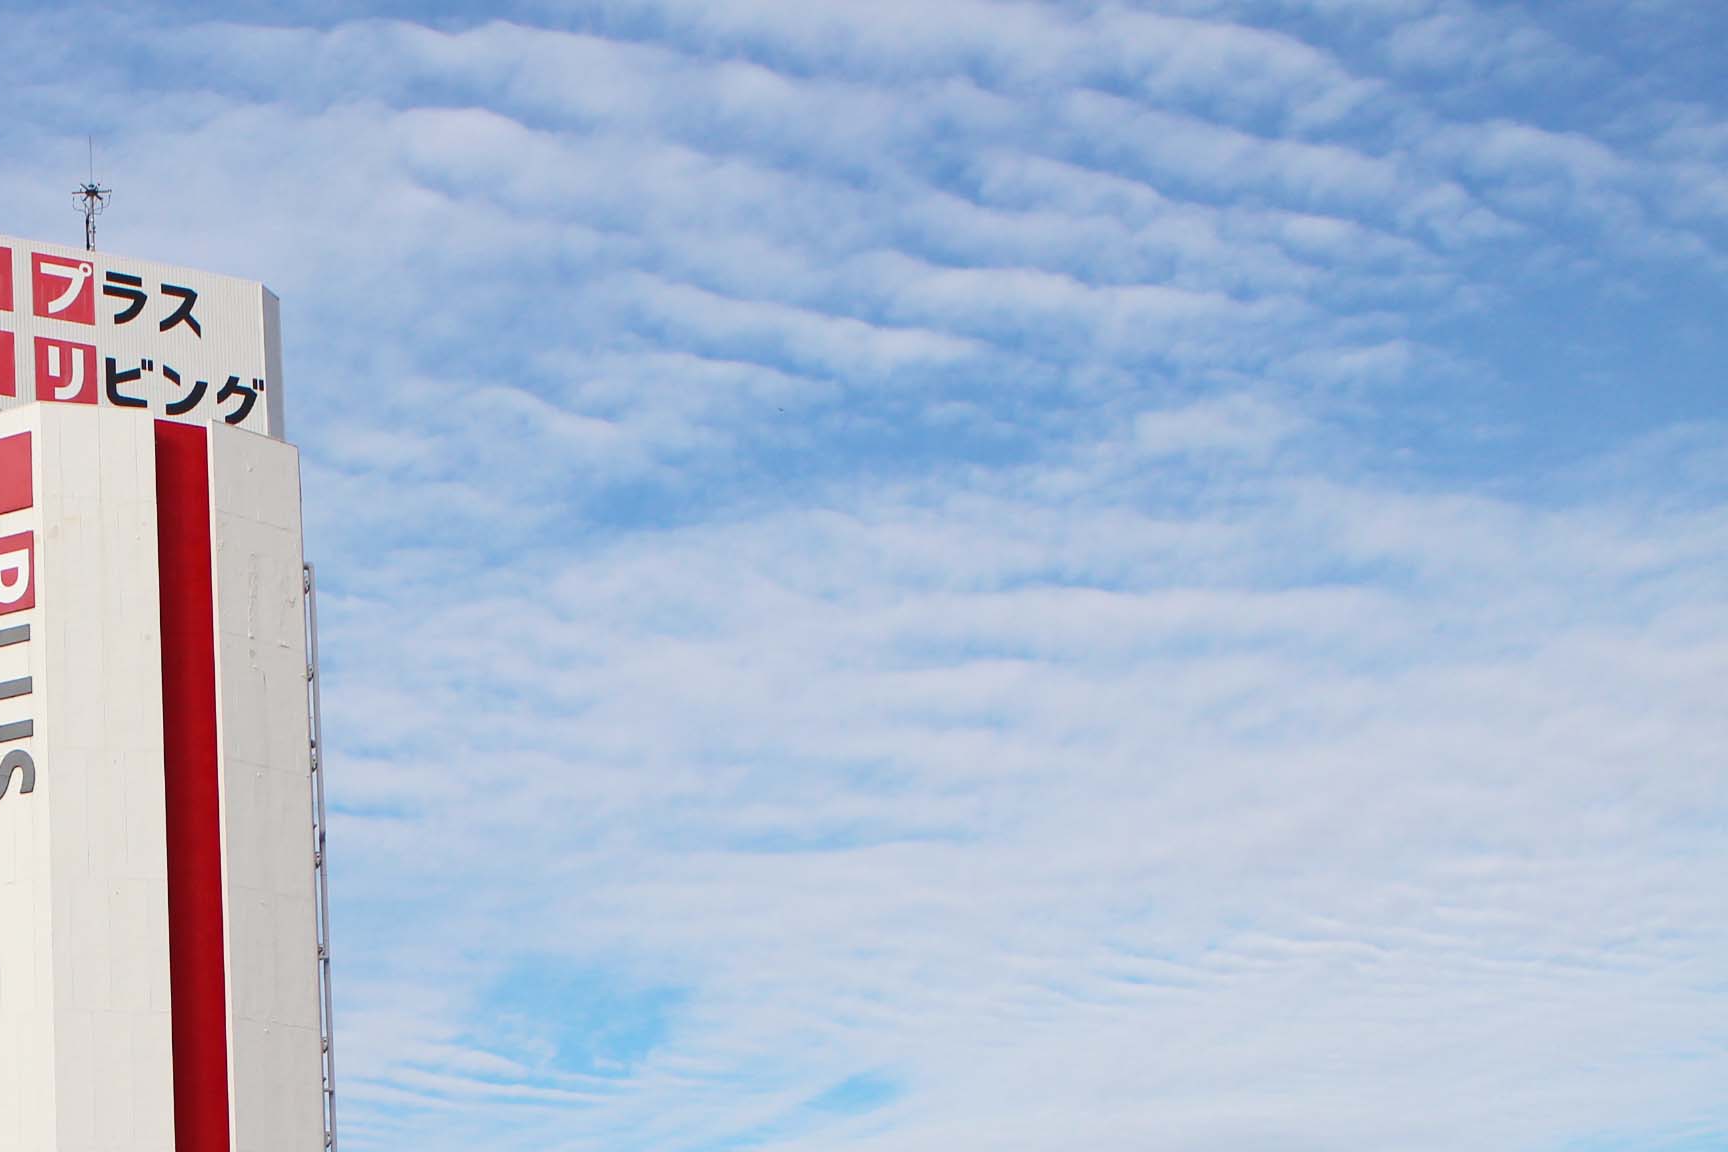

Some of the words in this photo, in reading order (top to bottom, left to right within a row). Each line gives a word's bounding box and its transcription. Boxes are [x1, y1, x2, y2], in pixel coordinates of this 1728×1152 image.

[40, 261, 202, 339] プラス
[48, 345, 265, 425] リビング
